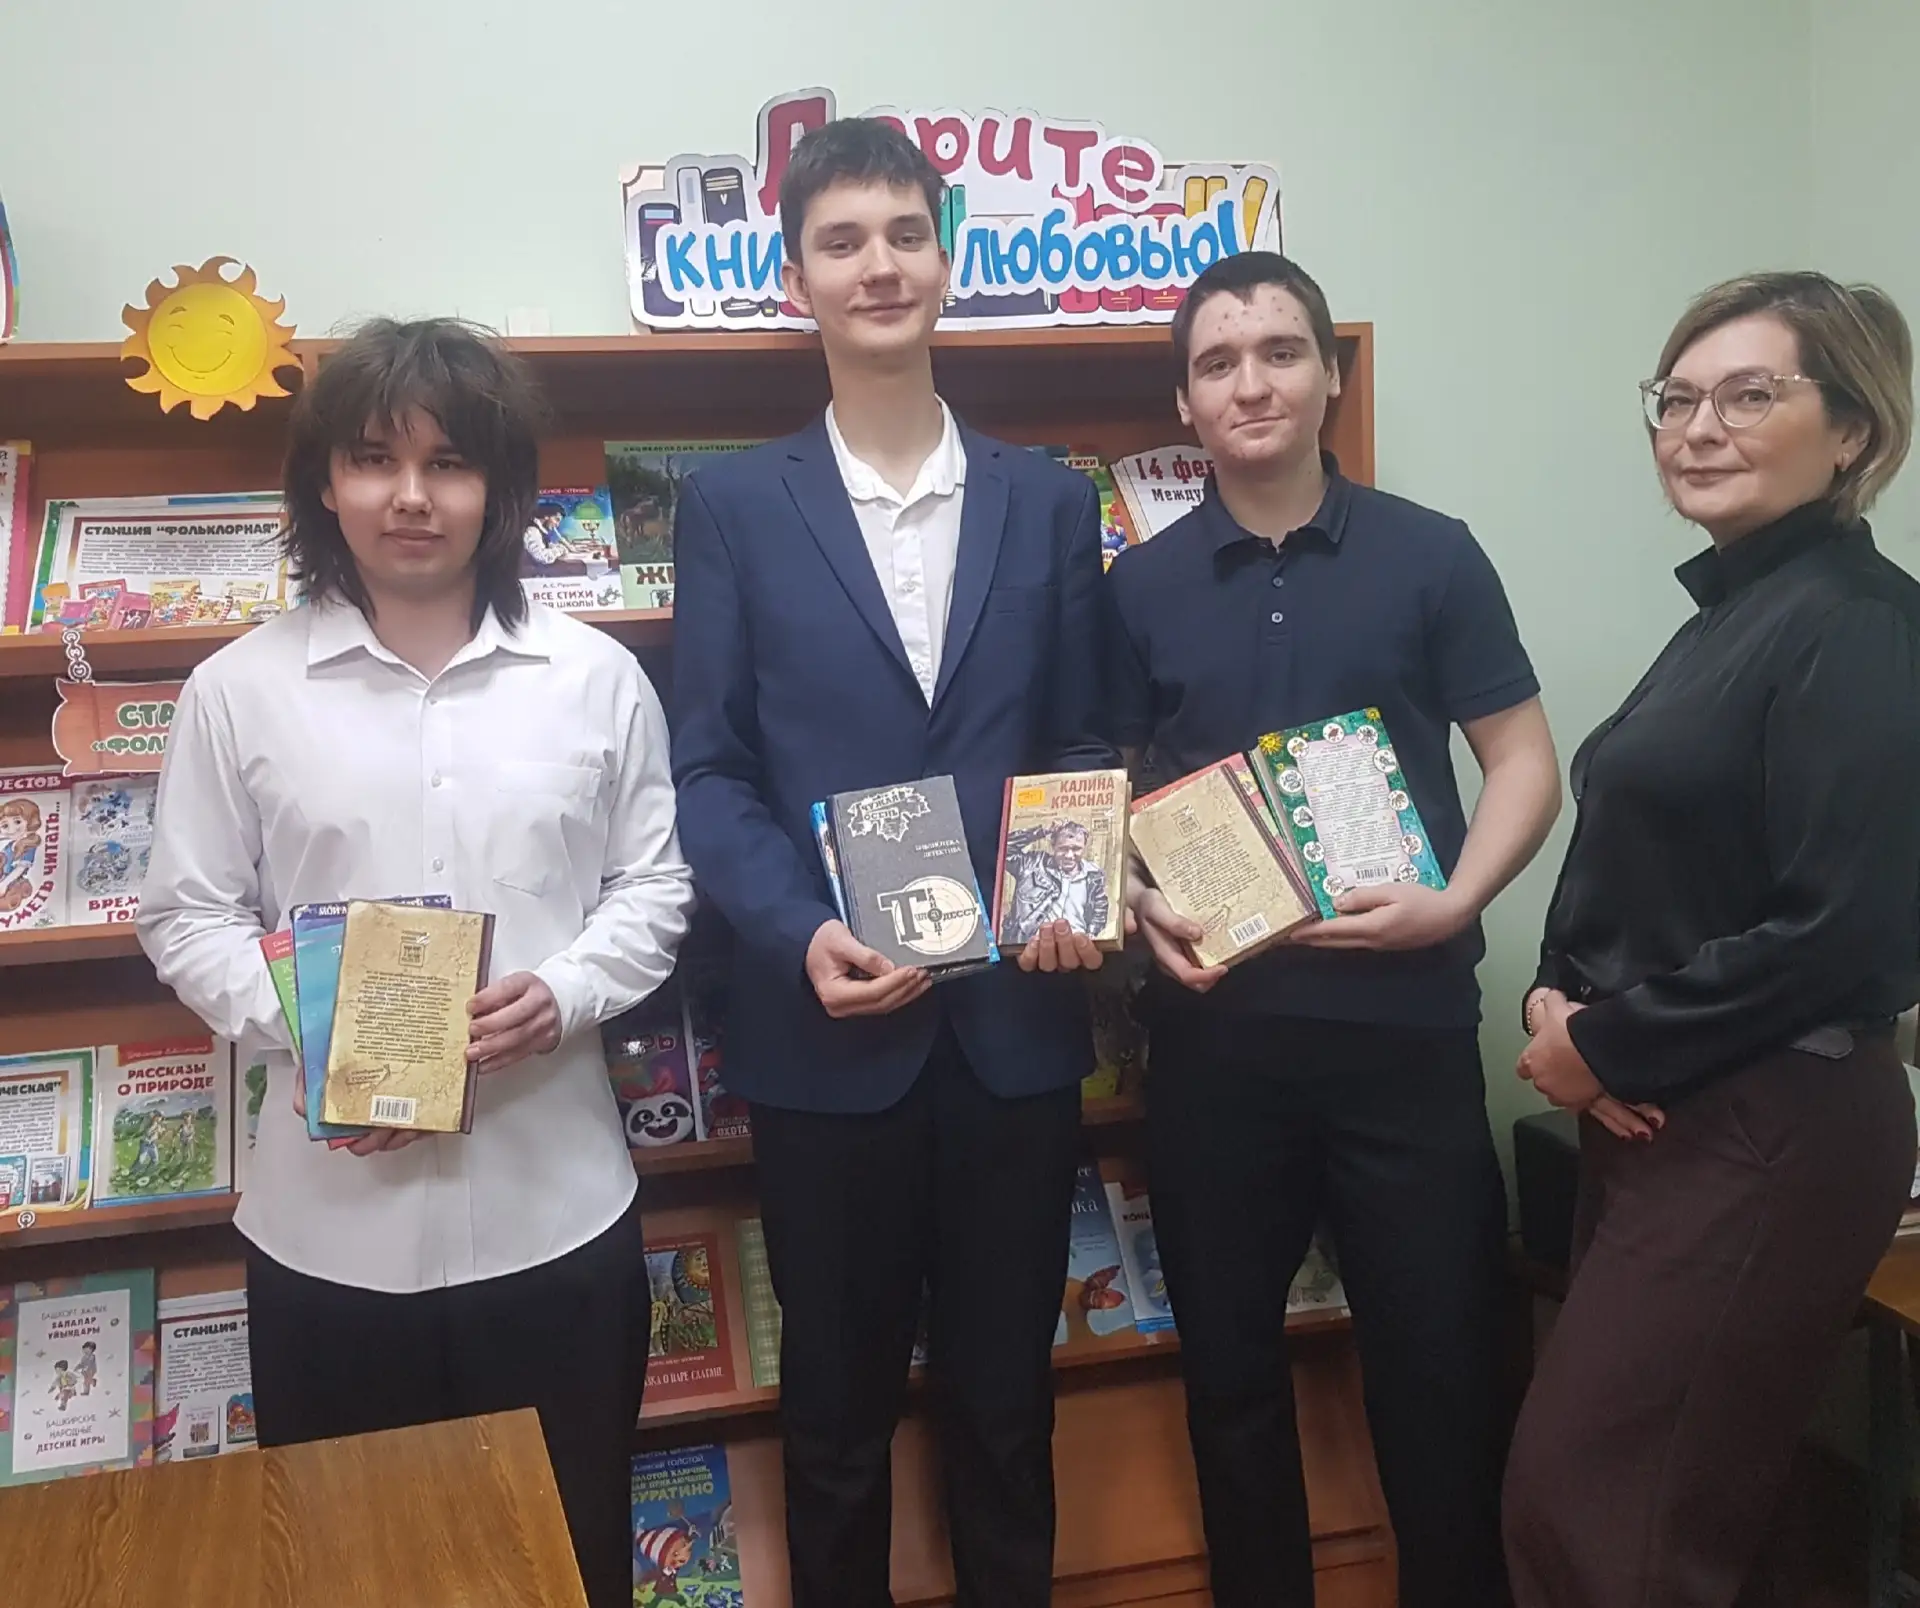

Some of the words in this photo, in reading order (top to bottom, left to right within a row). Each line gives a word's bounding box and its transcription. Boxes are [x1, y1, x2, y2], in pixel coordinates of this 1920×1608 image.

[757, 96, 1154, 215] Дрите
[665, 231, 783, 291] кни
[1135, 457, 1164, 481] 14
[1151, 487, 1204, 503] Между
[84, 525, 152, 536] СТАНЦИЯ
[533, 591, 554, 601] ВСЕ
[556, 590, 594, 600] СТИХИ
[557, 600, 594, 608] ШКОЛЫ
[1060, 777, 1115, 793] КАЛИНА
[1051, 792, 1114, 809] КРАСНАЯ
[88, 895, 140, 912] ВРЕМ
[128, 1063, 206, 1080] РАССКАЗЫ
[117, 1083, 132, 1096] О
[135, 1076, 214, 1093] ПРИРОДЕ
[717, 1125, 749, 1137] ОХОТА
[173, 1321, 238, 1339] СТАНЦИЯ
[36, 1438, 77, 1455] ДЕТСКИЕ
[80, 1434, 106, 1448] ИГРЫ
